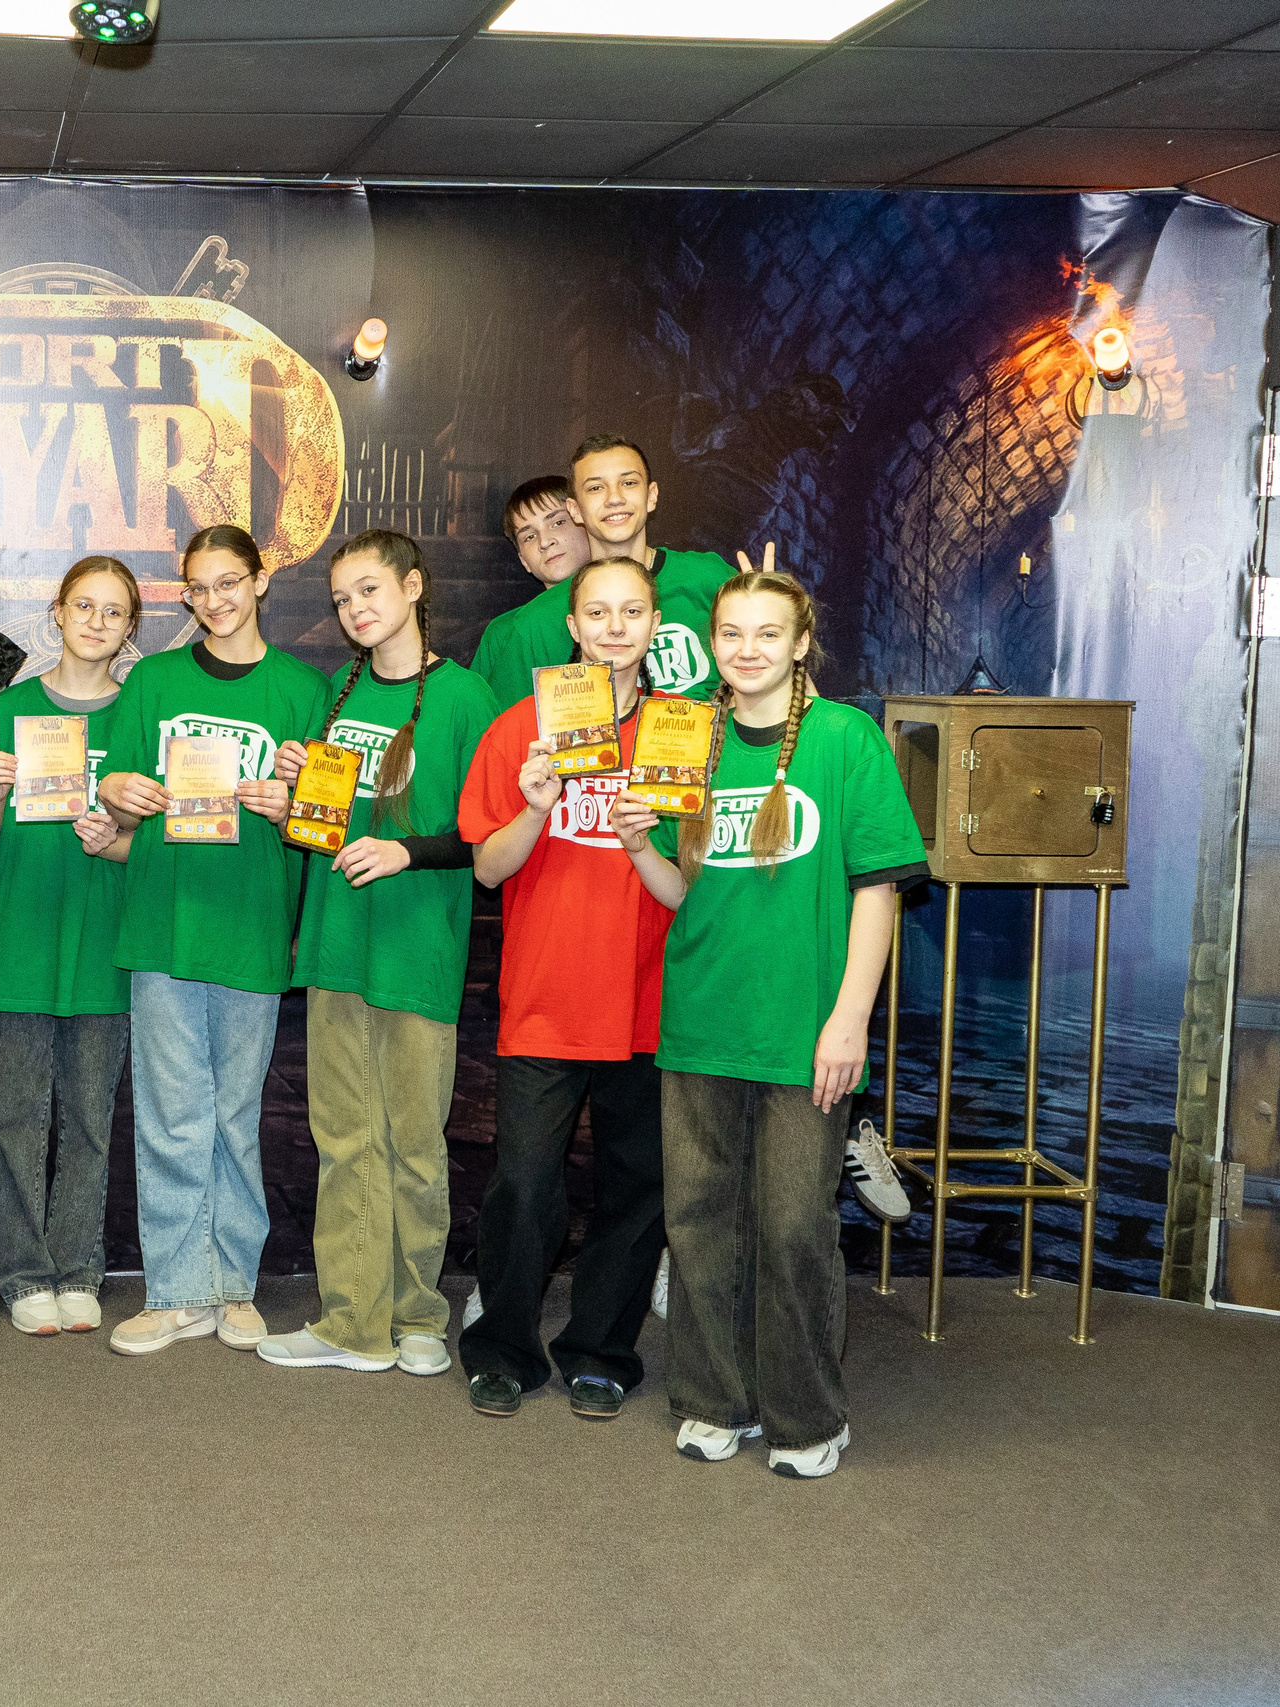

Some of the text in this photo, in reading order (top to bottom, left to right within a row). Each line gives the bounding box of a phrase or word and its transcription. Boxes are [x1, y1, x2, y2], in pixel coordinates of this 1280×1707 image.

[554, 681, 594, 698] ДИПЛОМ
[654, 717, 696, 731] ДИПЛОМ
[32, 733, 69, 745] ДИПЛОМ
[335, 727, 388, 748] FORT
[313, 759, 345, 775] ДИПЛОМ
[581, 777, 629, 793] FOR
[715, 796, 765, 813] FOR
